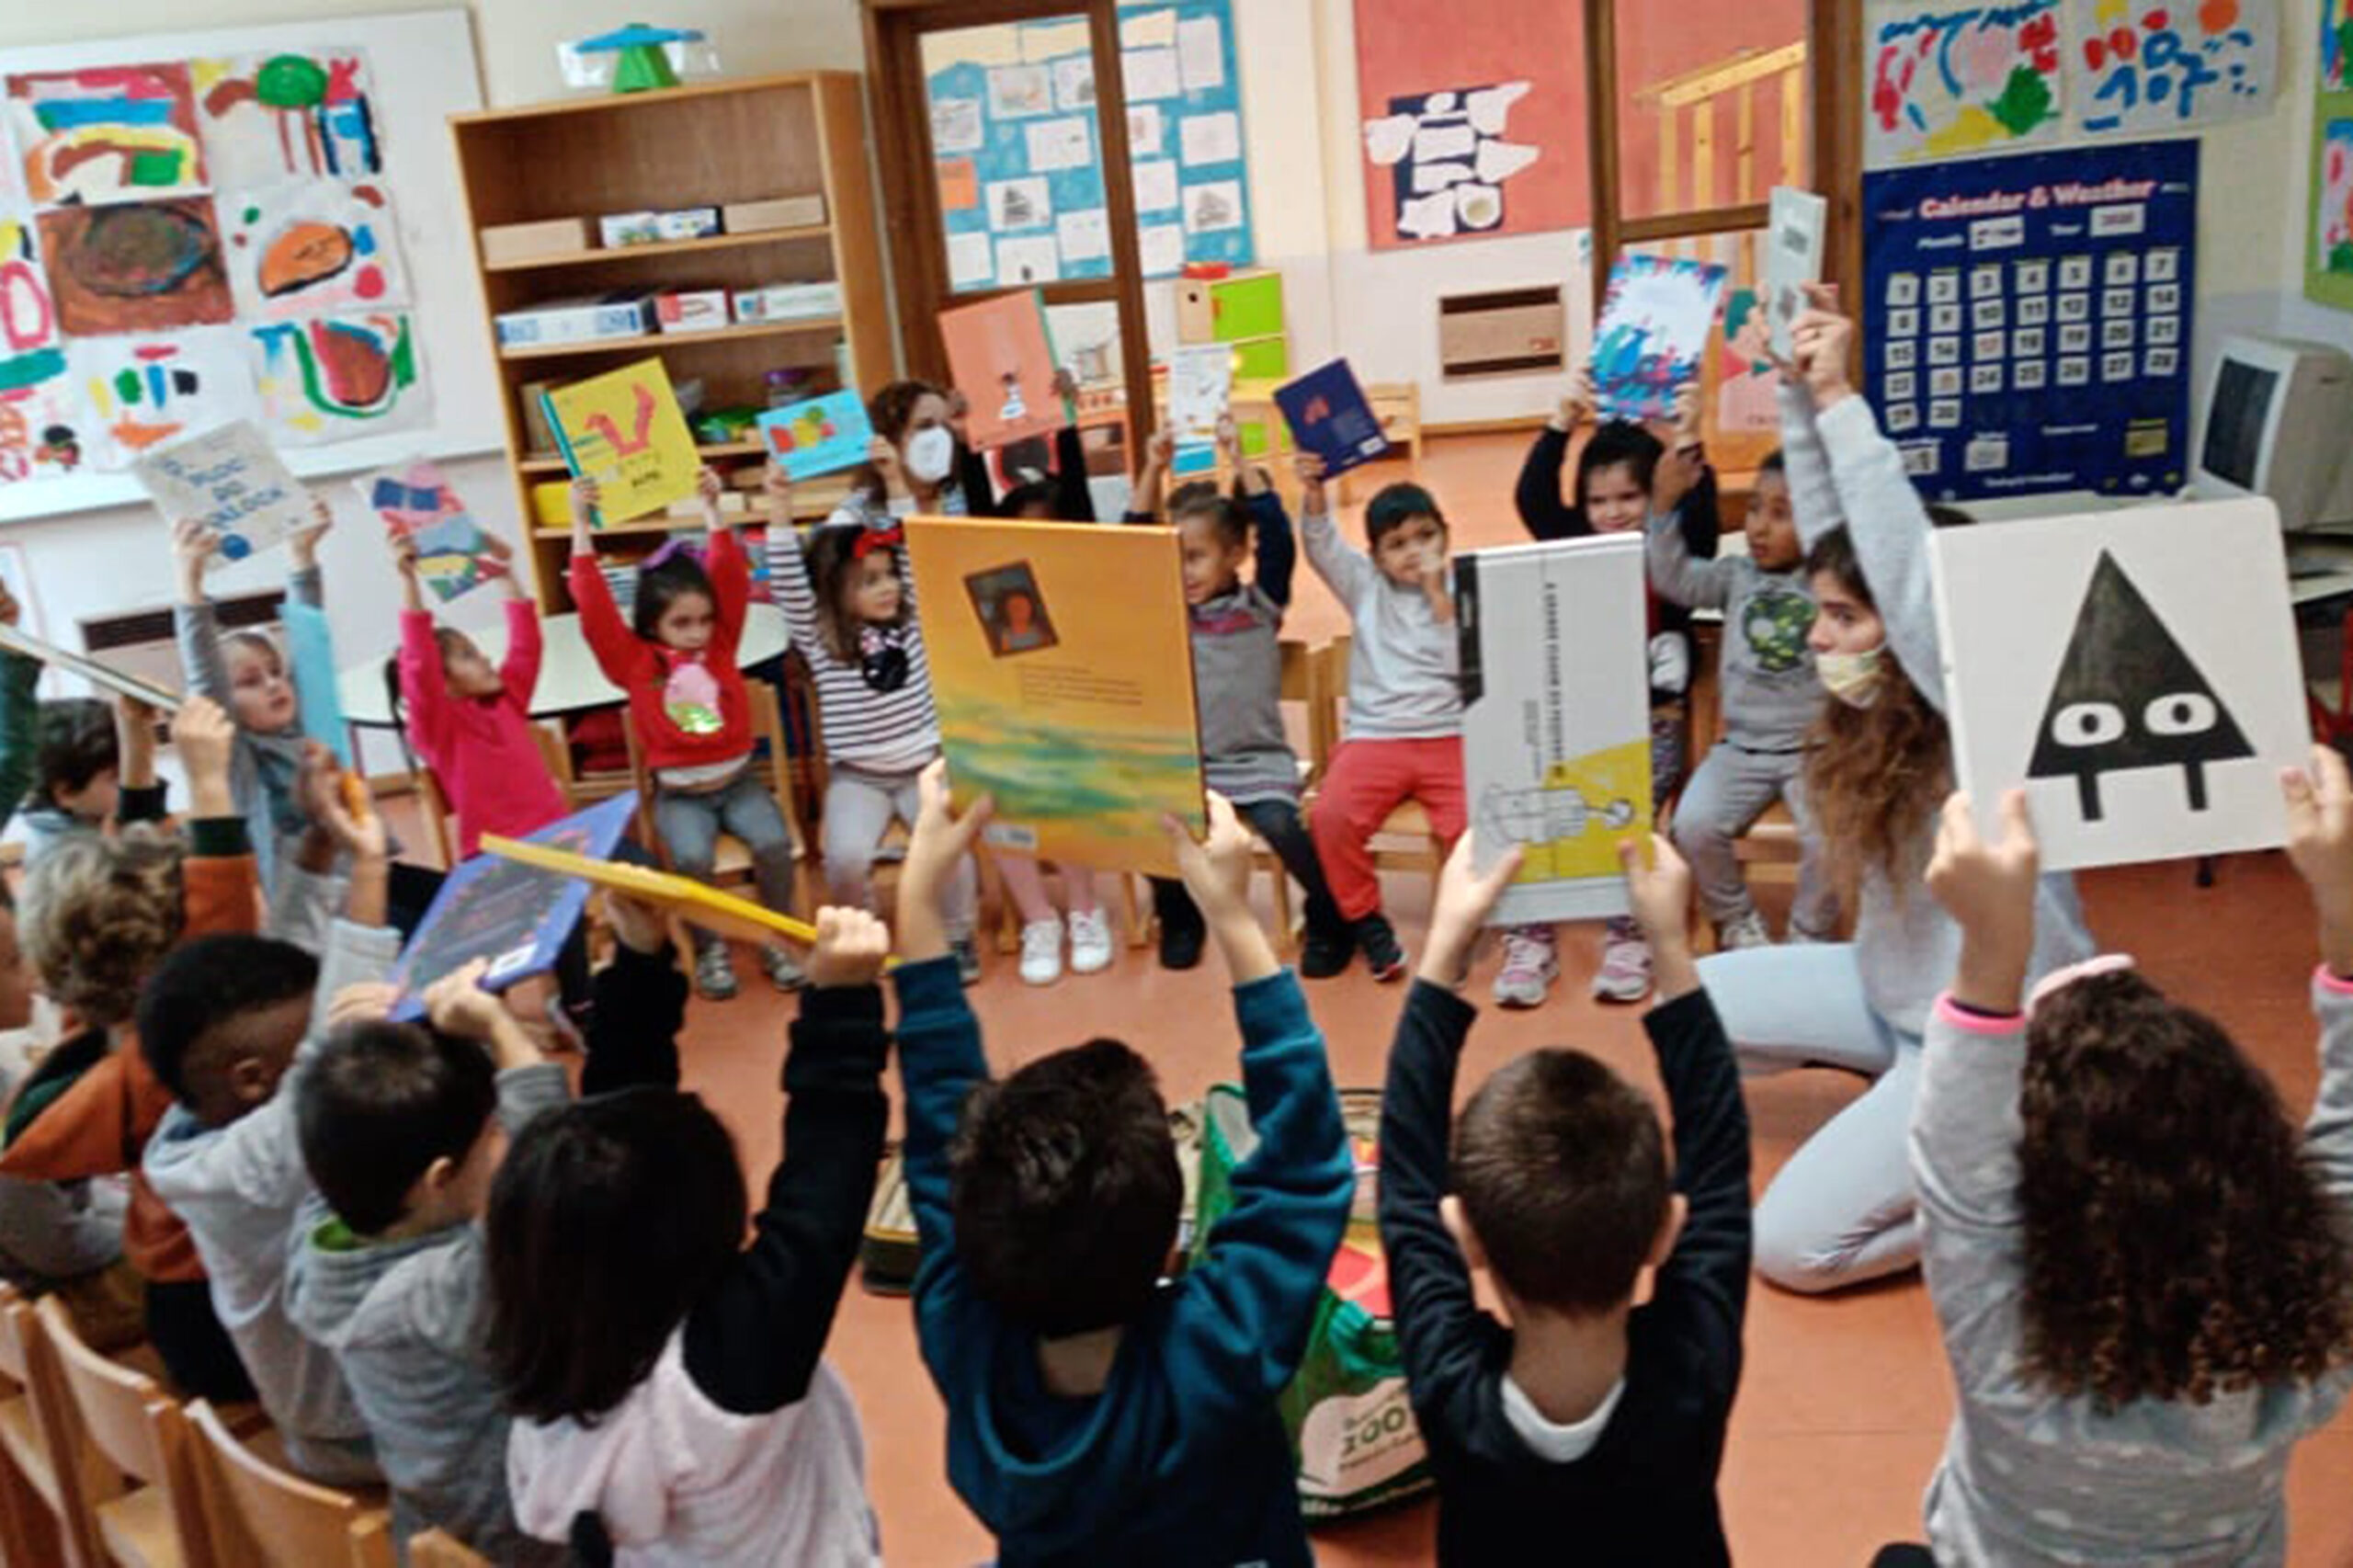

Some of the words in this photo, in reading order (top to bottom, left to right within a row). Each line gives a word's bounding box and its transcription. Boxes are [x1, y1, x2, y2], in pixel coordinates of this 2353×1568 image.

[1918, 189, 2026, 220] Calendar
[2028, 186, 2050, 209] &
[2052, 178, 2157, 205] Weather
